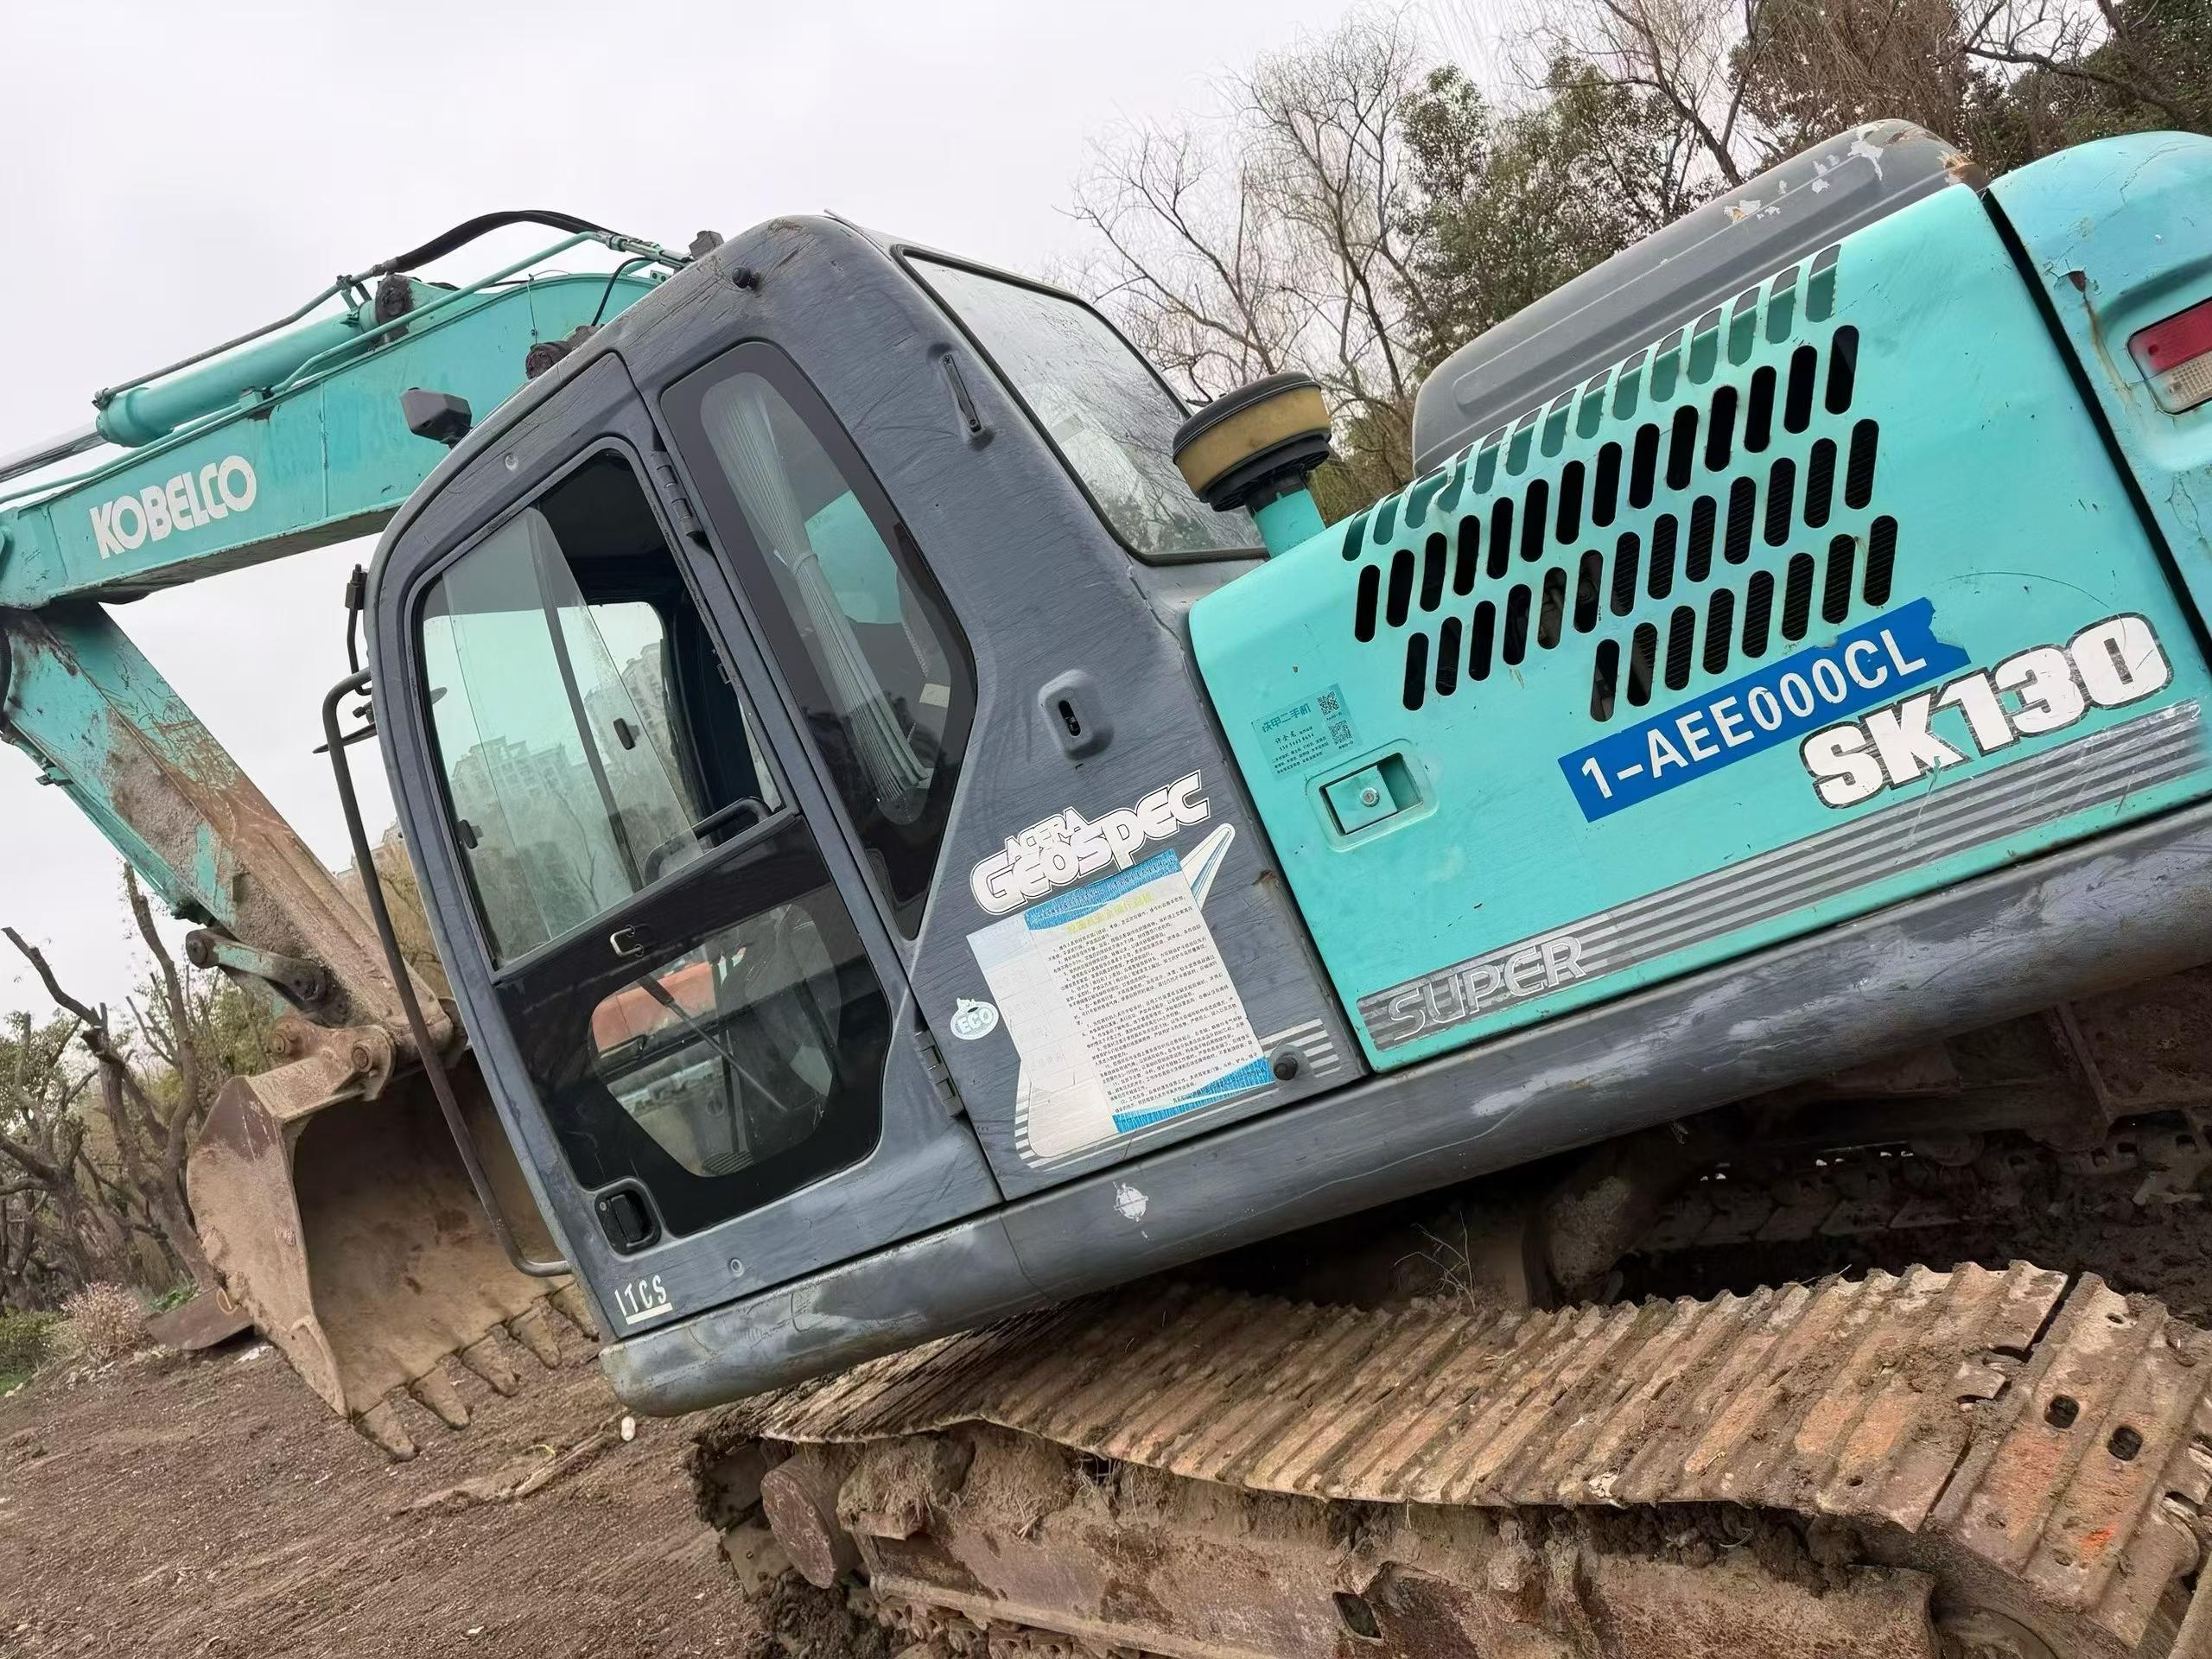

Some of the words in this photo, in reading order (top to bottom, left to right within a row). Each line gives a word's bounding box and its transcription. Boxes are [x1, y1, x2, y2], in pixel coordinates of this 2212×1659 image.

[90, 455, 257, 560] KOBELCO
[1580, 628, 1929, 799] 1-AEE000CL
[1799, 613, 2174, 810] SK130
[956, 1007, 994, 1034] ECO
[1388, 936, 1586, 1041] SUPER
